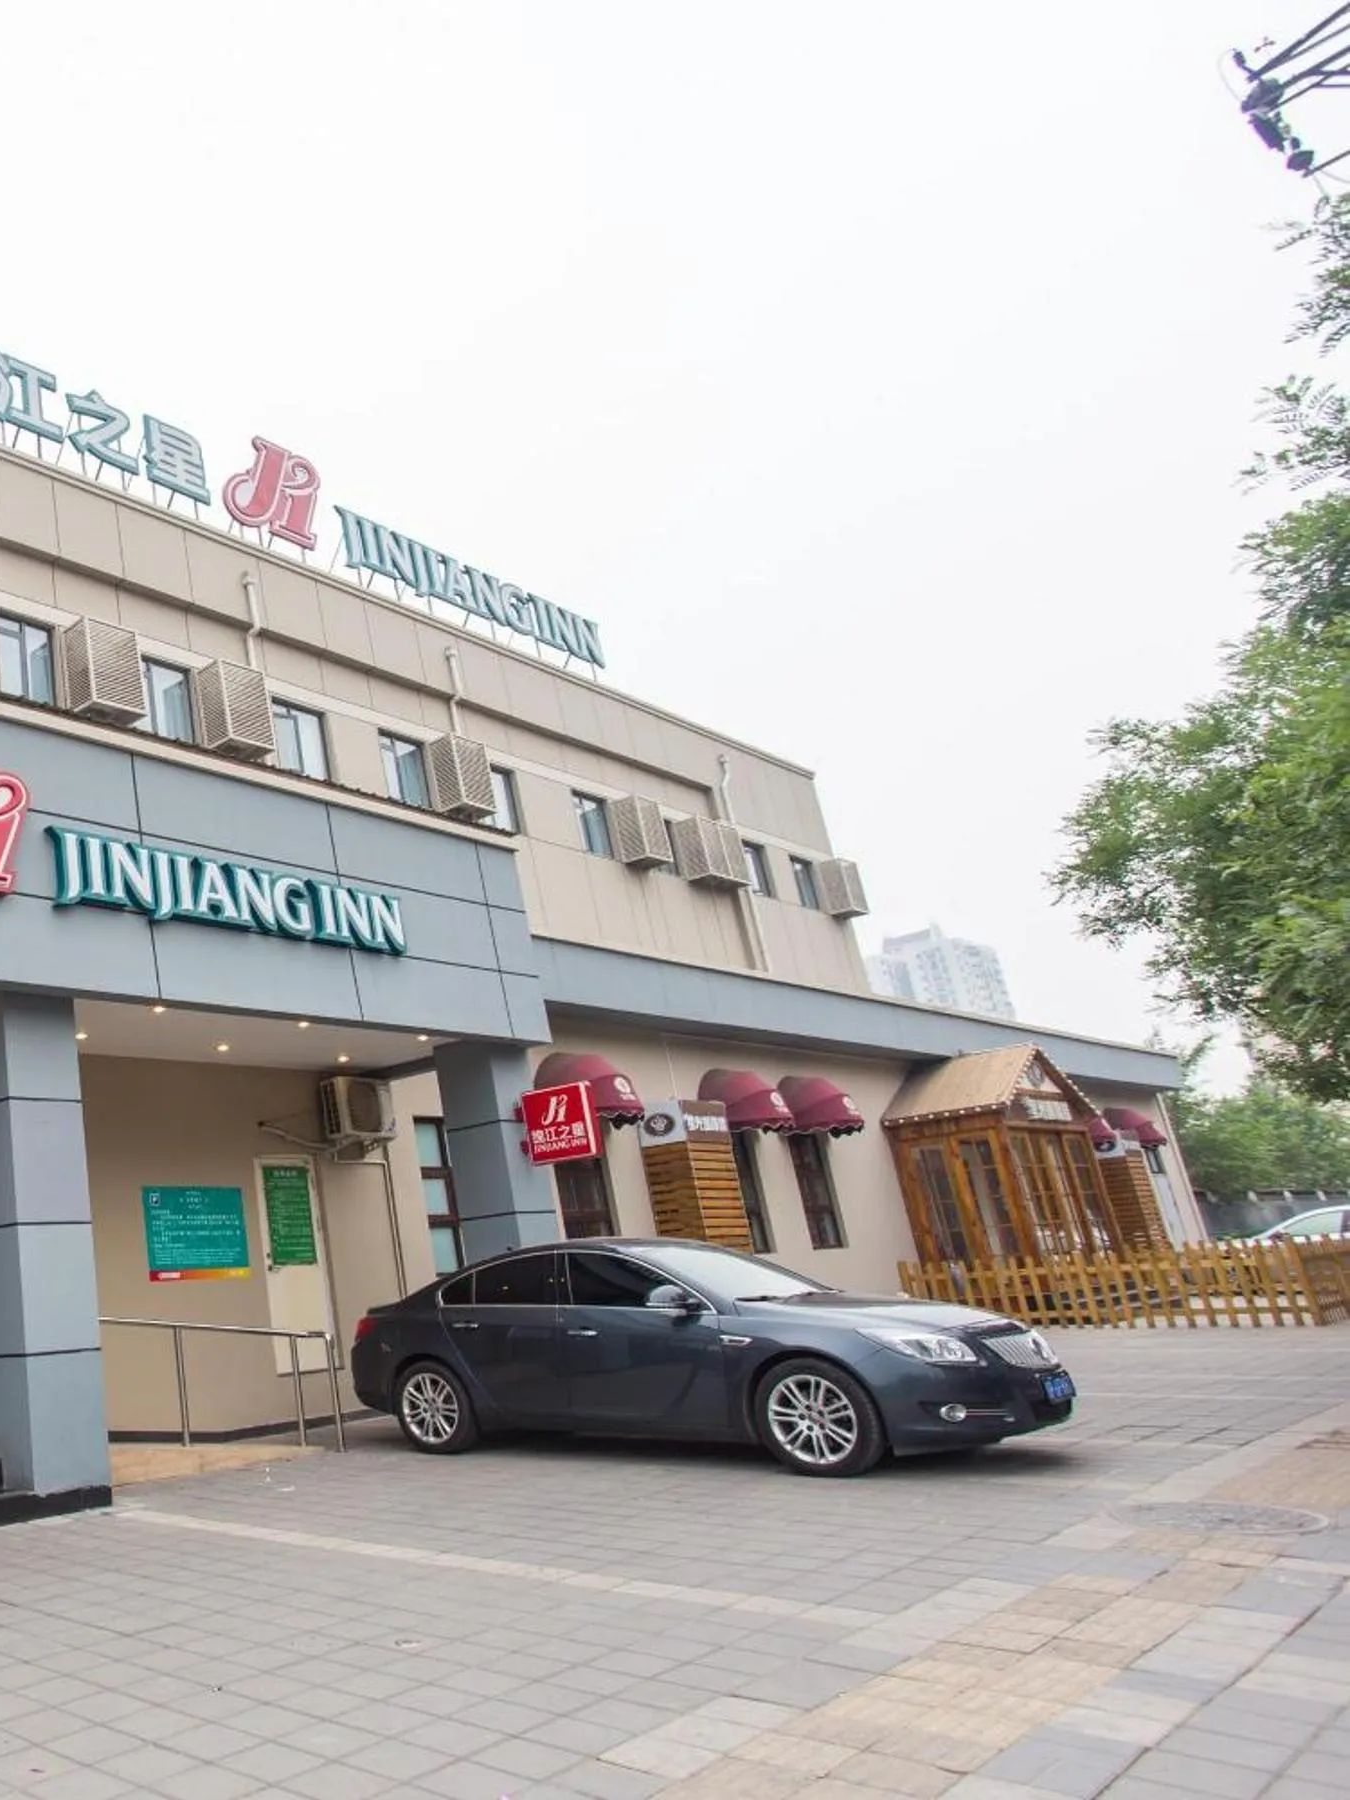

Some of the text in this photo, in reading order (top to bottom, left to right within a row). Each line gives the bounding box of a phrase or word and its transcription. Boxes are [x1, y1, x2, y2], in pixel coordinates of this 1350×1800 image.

[333, 505, 535, 637] JINJIANG
[526, 592, 606, 669] INN
[46, 826, 314, 940] JINJIANG
[306, 879, 407, 956] INN
